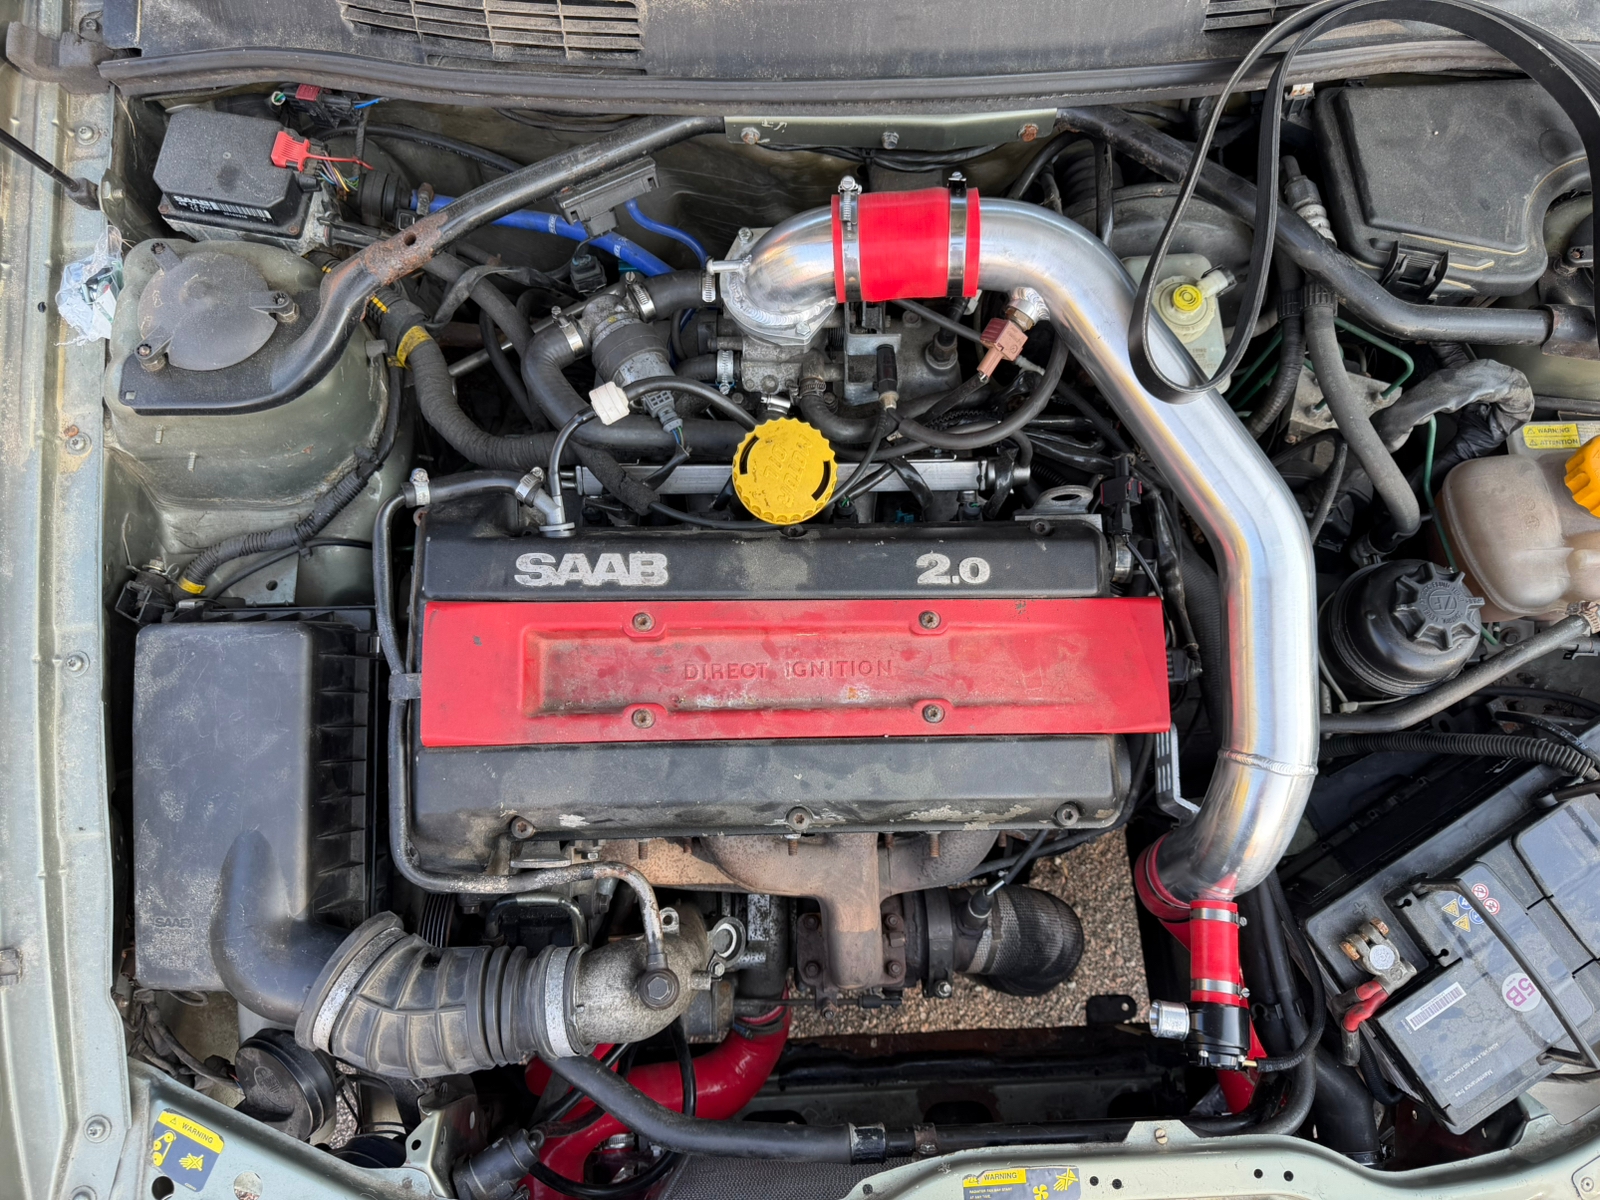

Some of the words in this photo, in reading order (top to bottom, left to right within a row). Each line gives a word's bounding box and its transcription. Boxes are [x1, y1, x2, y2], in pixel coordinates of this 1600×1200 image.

[173, 195, 212, 208] SAAB
[1540, 438, 1578, 446] ATTENTION
[762, 443, 787, 480] OIL
[514, 552, 669, 586] SAAB
[916, 552, 990, 584] 2.0
[684, 661, 768, 681] DIRECT
[785, 659, 893, 679] IGNITION
[1505, 977, 1536, 1007] 5B
[1442, 1066, 1464, 1083] FUNCTION
[1462, 1068, 1494, 1091] Maintenance
[181, 1122, 214, 1144] WARNING
[983, 1172, 1018, 1181] WARNING
